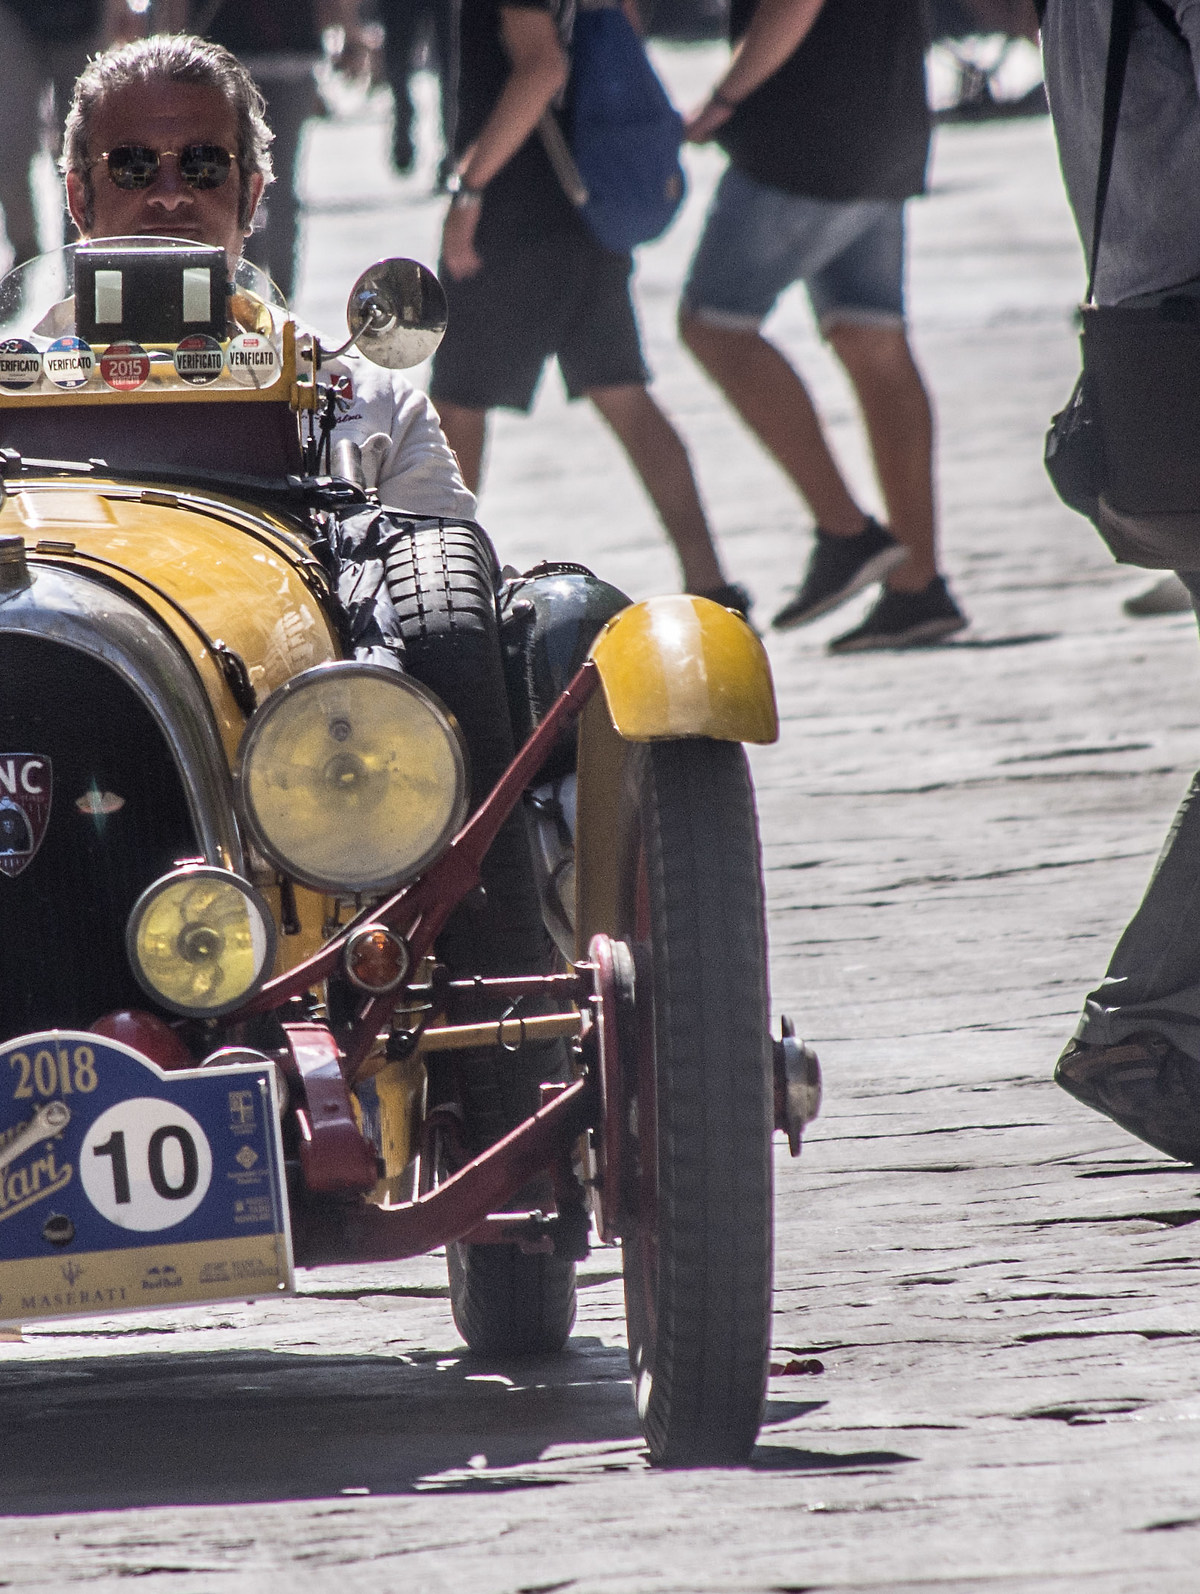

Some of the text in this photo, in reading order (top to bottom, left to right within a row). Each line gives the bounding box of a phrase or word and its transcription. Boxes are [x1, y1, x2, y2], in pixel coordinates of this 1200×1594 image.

[47, 357, 92, 371] VERIFICATO
[177, 353, 222, 370] VERIFICATO
[230, 352, 274, 366] VERIFICATO
[109, 359, 142, 377] 2015
[112, 375, 140, 385] VERIFICATO
[9, 1045, 99, 1100] 2018
[92, 1123, 200, 1206] 10
[21, 1287, 126, 1309] MASERATI
